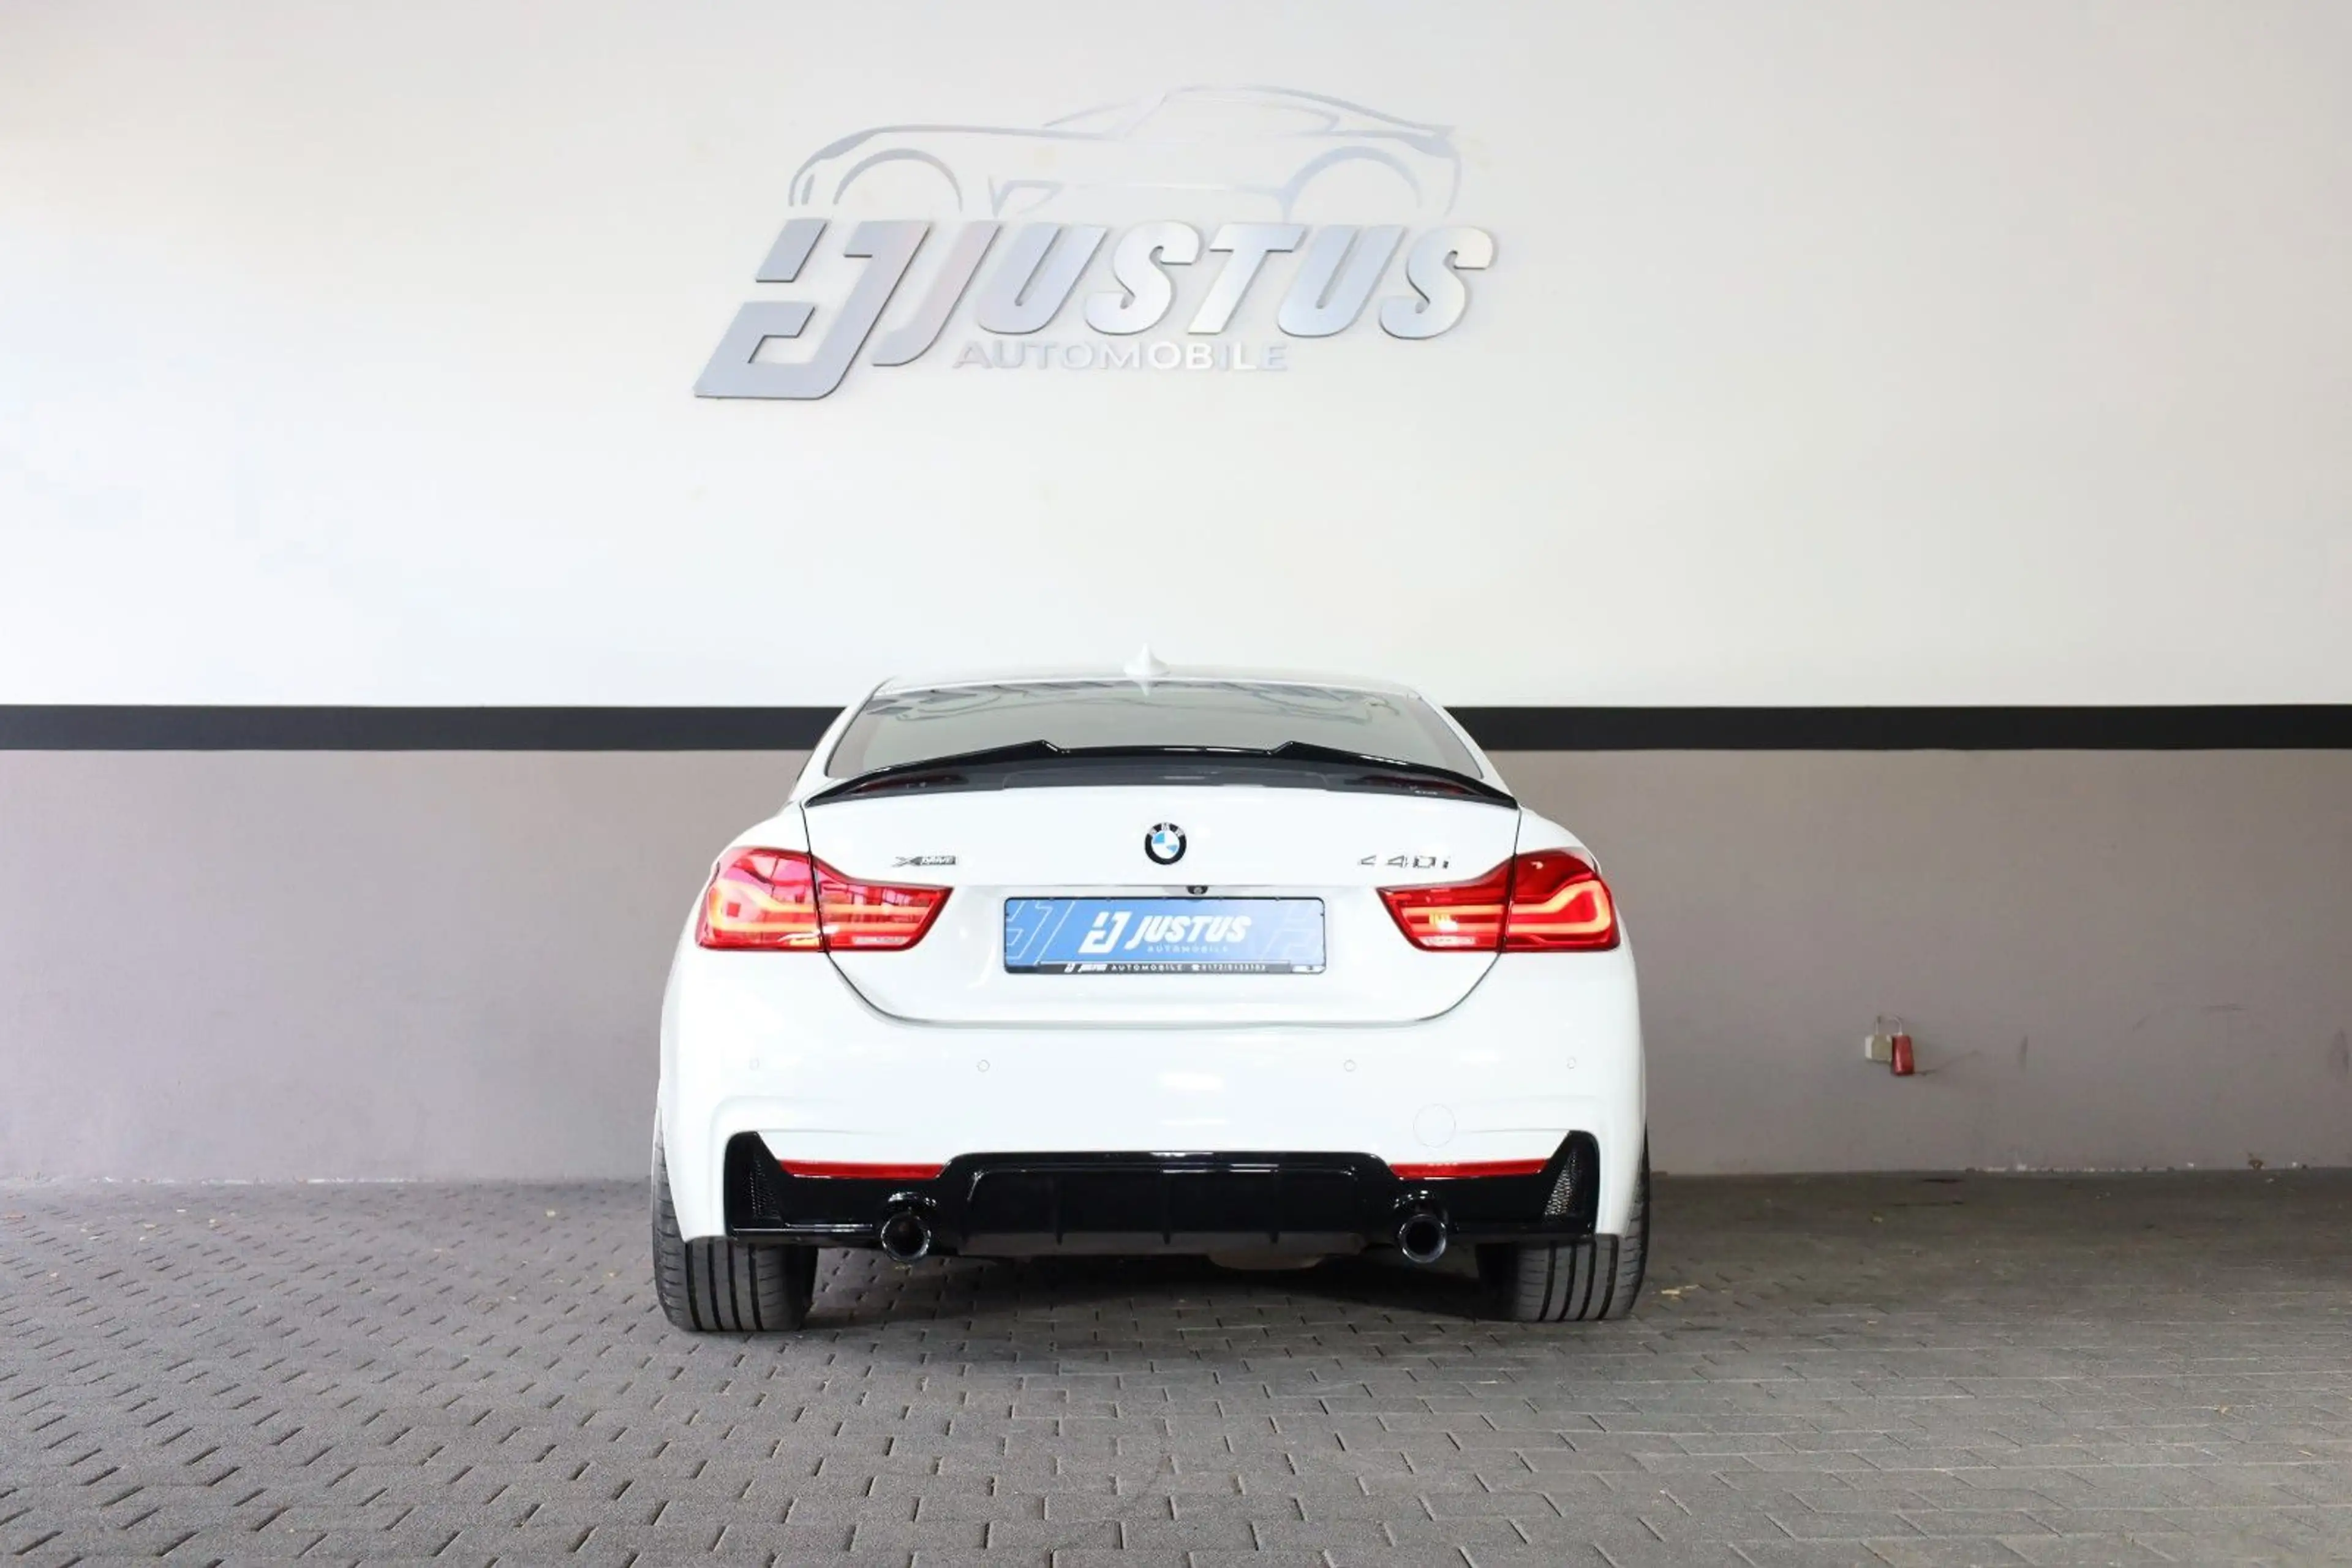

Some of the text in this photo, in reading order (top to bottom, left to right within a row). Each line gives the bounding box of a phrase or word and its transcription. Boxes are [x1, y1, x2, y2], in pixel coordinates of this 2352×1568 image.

[873, 219, 1497, 366] JUSTUS
[952, 341, 1288, 371] AUTOMOBILE
[1125, 914, 1252, 950] JUSTUS
